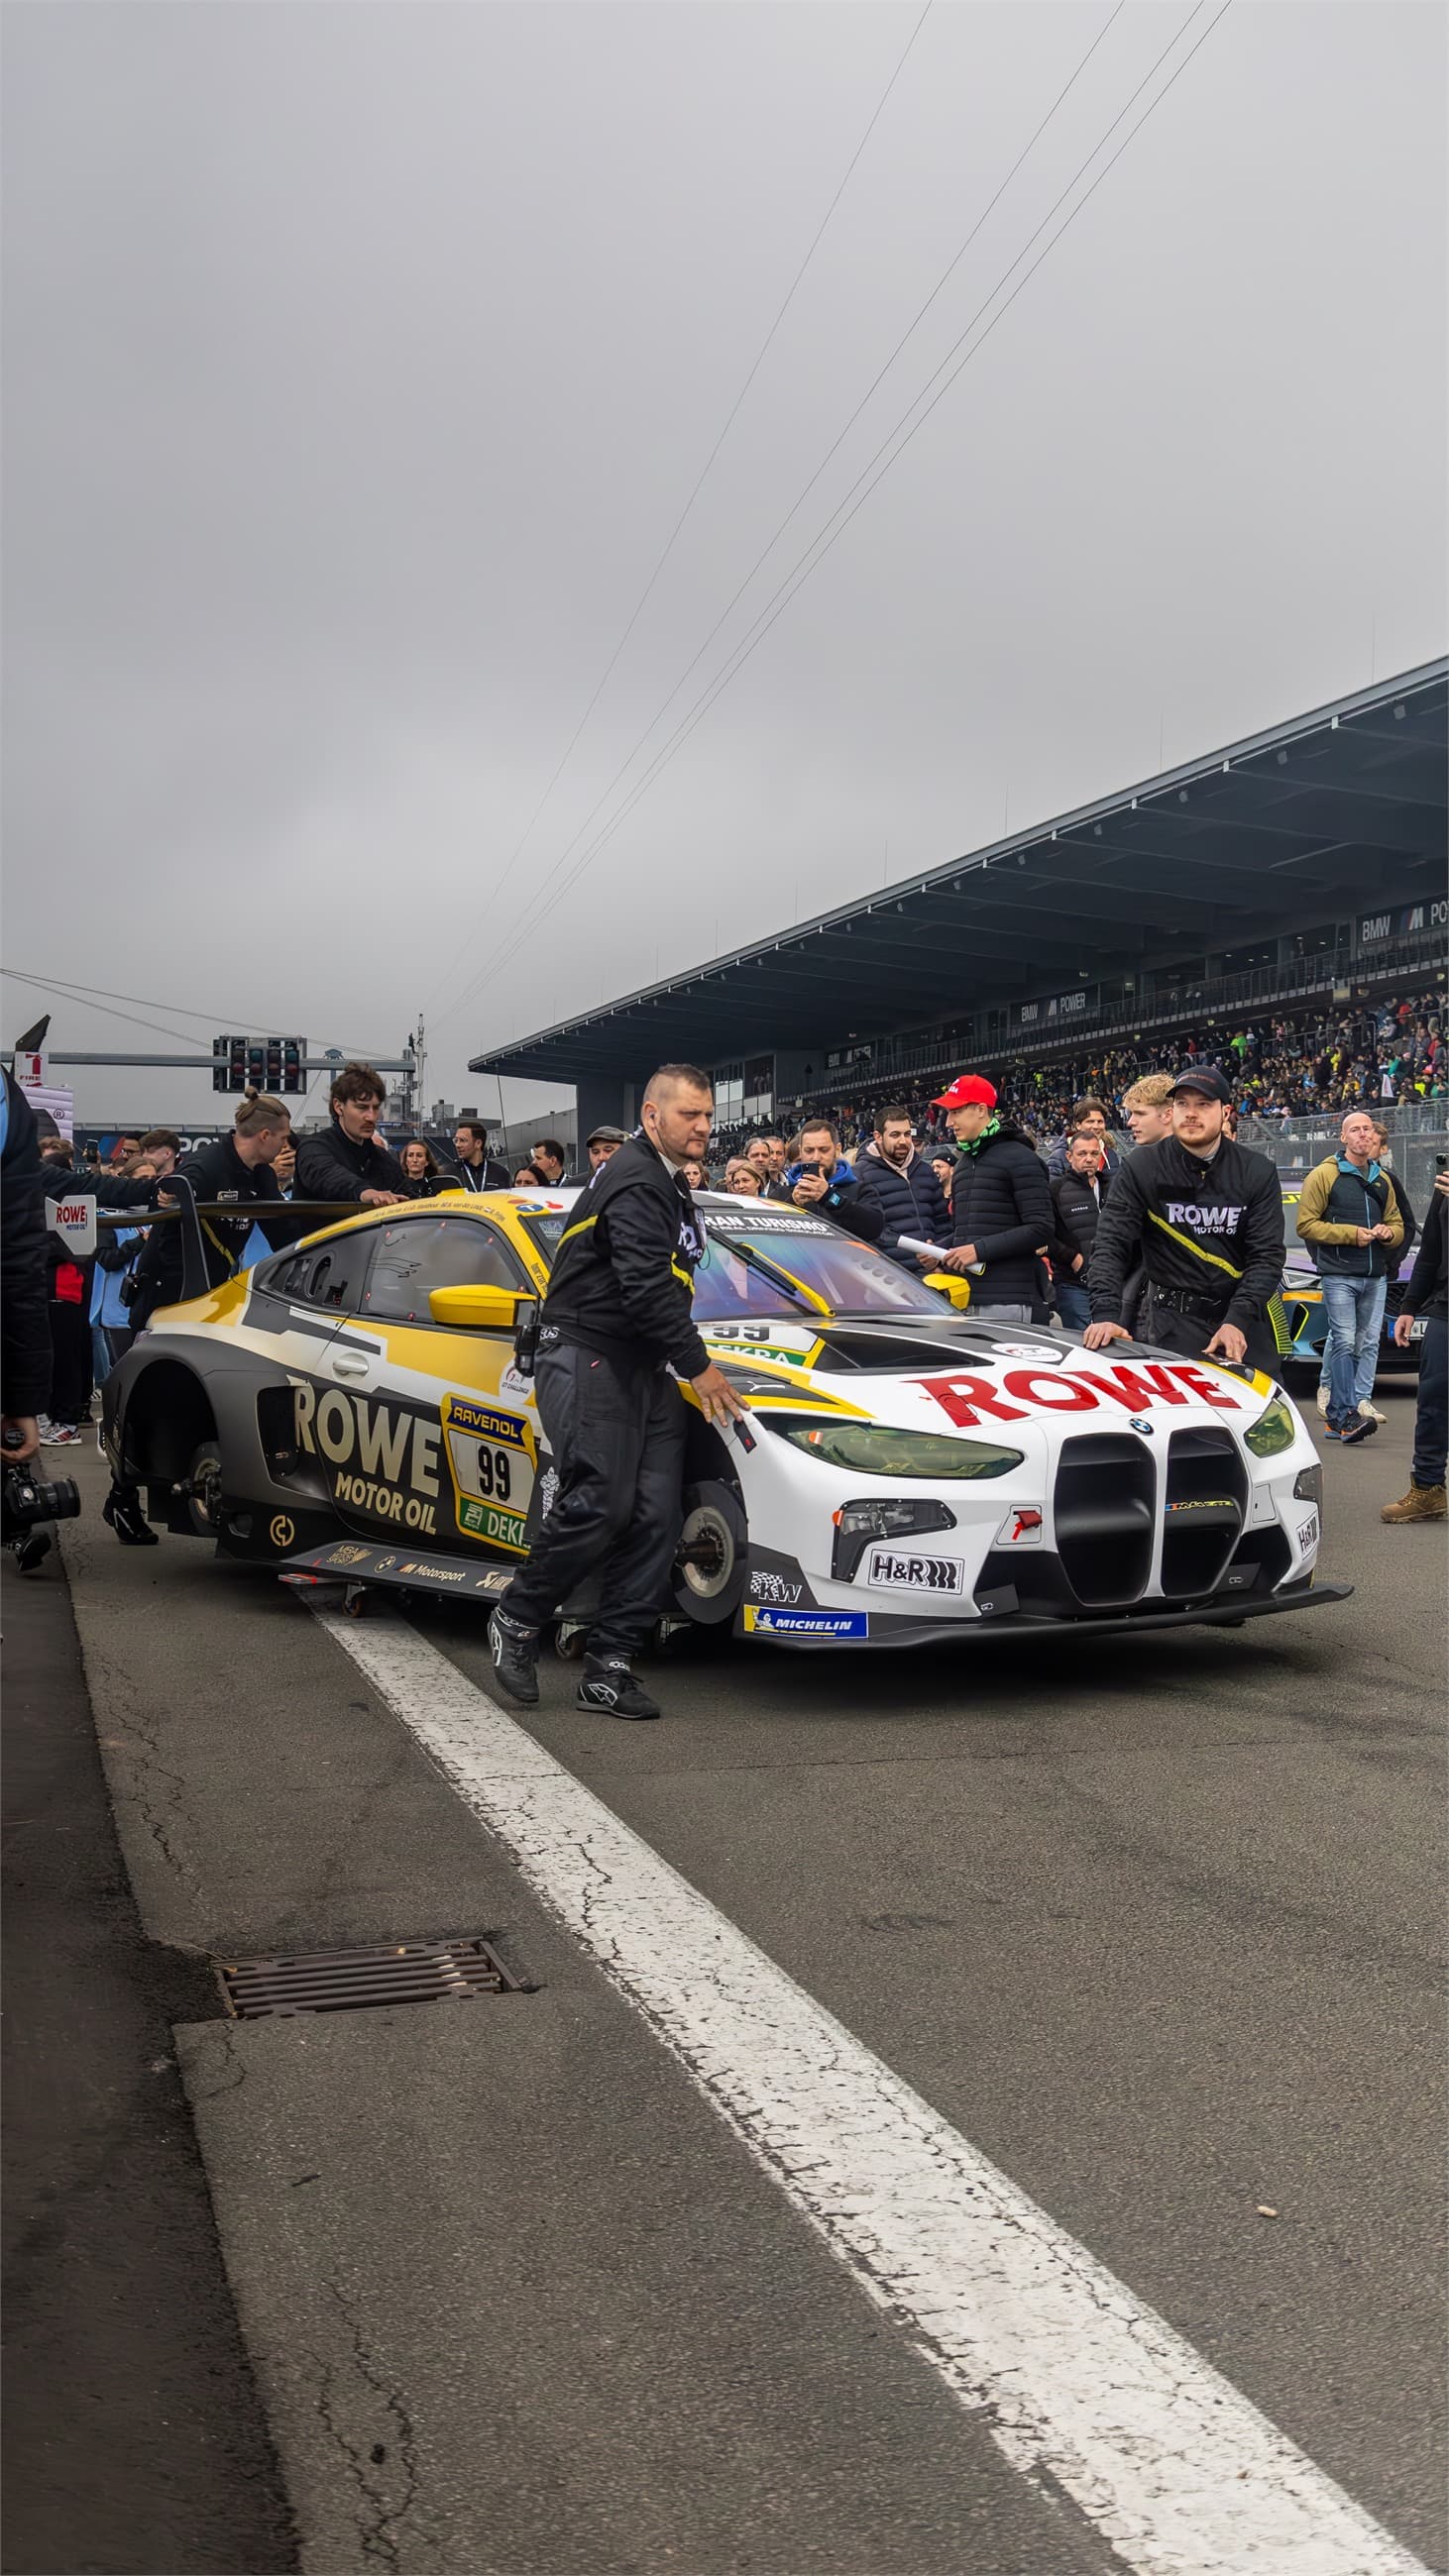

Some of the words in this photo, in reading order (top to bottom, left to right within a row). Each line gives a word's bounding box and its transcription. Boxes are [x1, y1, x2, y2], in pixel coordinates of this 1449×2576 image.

[1363, 914, 1391, 942] BMW
[1431, 900, 1449, 925] PO
[1021, 1004, 1039, 1022] BMW
[1059, 993, 1086, 1014] POWER
[56, 1205, 86, 1224] ROWE
[704, 1216, 744, 1228] RAN
[743, 1217, 827, 1233] TURISMO
[1166, 1203, 1243, 1228] ROWE
[899, 1363, 1243, 1429] ROWE
[286, 1373, 443, 1498] ROWE
[453, 1405, 519, 1439] RAVENOL
[477, 1445, 511, 1502] 99
[334, 1470, 404, 1523] MOTOR
[404, 1502, 438, 1536] OIL
[414, 1565, 466, 1582] Motorsport
[873, 1556, 924, 1583] H&R
[758, 1582, 803, 1604] KW
[775, 1618, 852, 1631] MICHELIN
